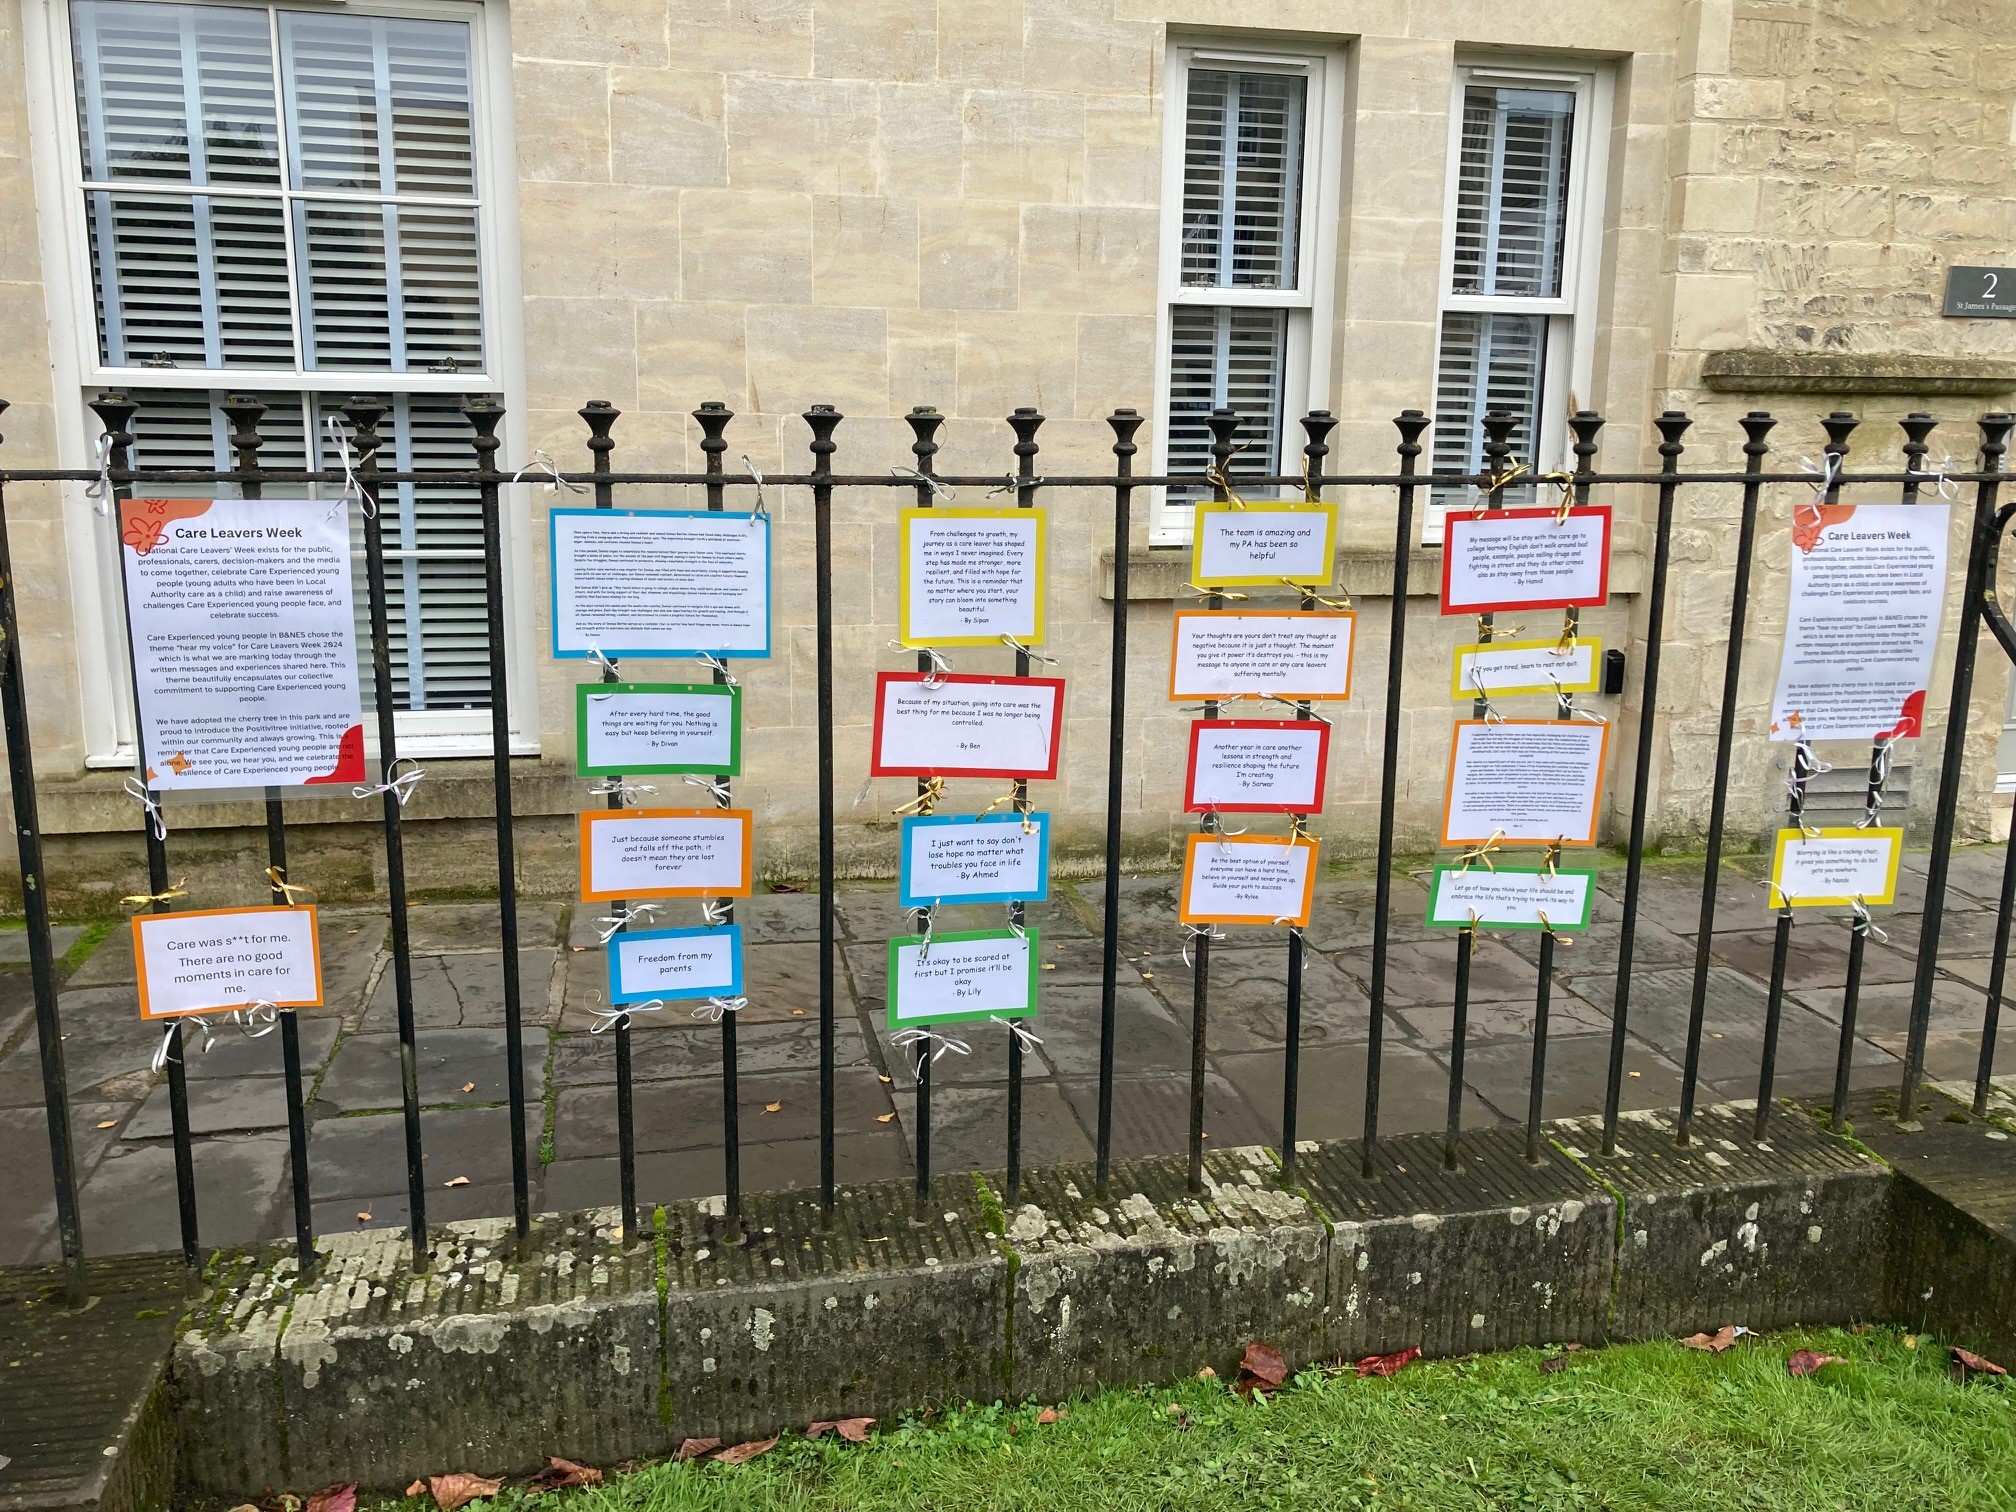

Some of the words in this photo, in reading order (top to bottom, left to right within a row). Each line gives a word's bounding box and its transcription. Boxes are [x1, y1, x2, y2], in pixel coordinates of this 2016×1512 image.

[1982, 273, 1998, 298] 2
[1964, 302, 1990, 310] James's
[175, 528, 206, 538] Care
[210, 528, 262, 538] Leavers
[265, 527, 302, 537] Week
[1264, 530, 1295, 538] amazing
[1828, 532, 1849, 540] Care
[1886, 530, 1911, 539] Week
[1249, 551, 1275, 561] helpful
[685, 720, 710, 728] Nothing
[937, 840, 953, 849] just
[945, 850, 963, 858] hope
[166, 941, 196, 950] Care
[198, 938, 222, 947] was
[251, 934, 267, 943] for
[178, 957, 212, 966] There
[215, 955, 234, 963] are
[254, 951, 282, 962] good
[638, 954, 675, 962] Freedom
[932, 958, 950, 966] okay
[974, 953, 999, 962] scared
[659, 965, 692, 974] parents
[956, 966, 986, 975] promise
[174, 971, 231, 983] moments
[234, 968, 244, 977] in
[275, 966, 290, 975] for
[954, 978, 971, 986] okay
[968, 987, 981, 996] Lily
